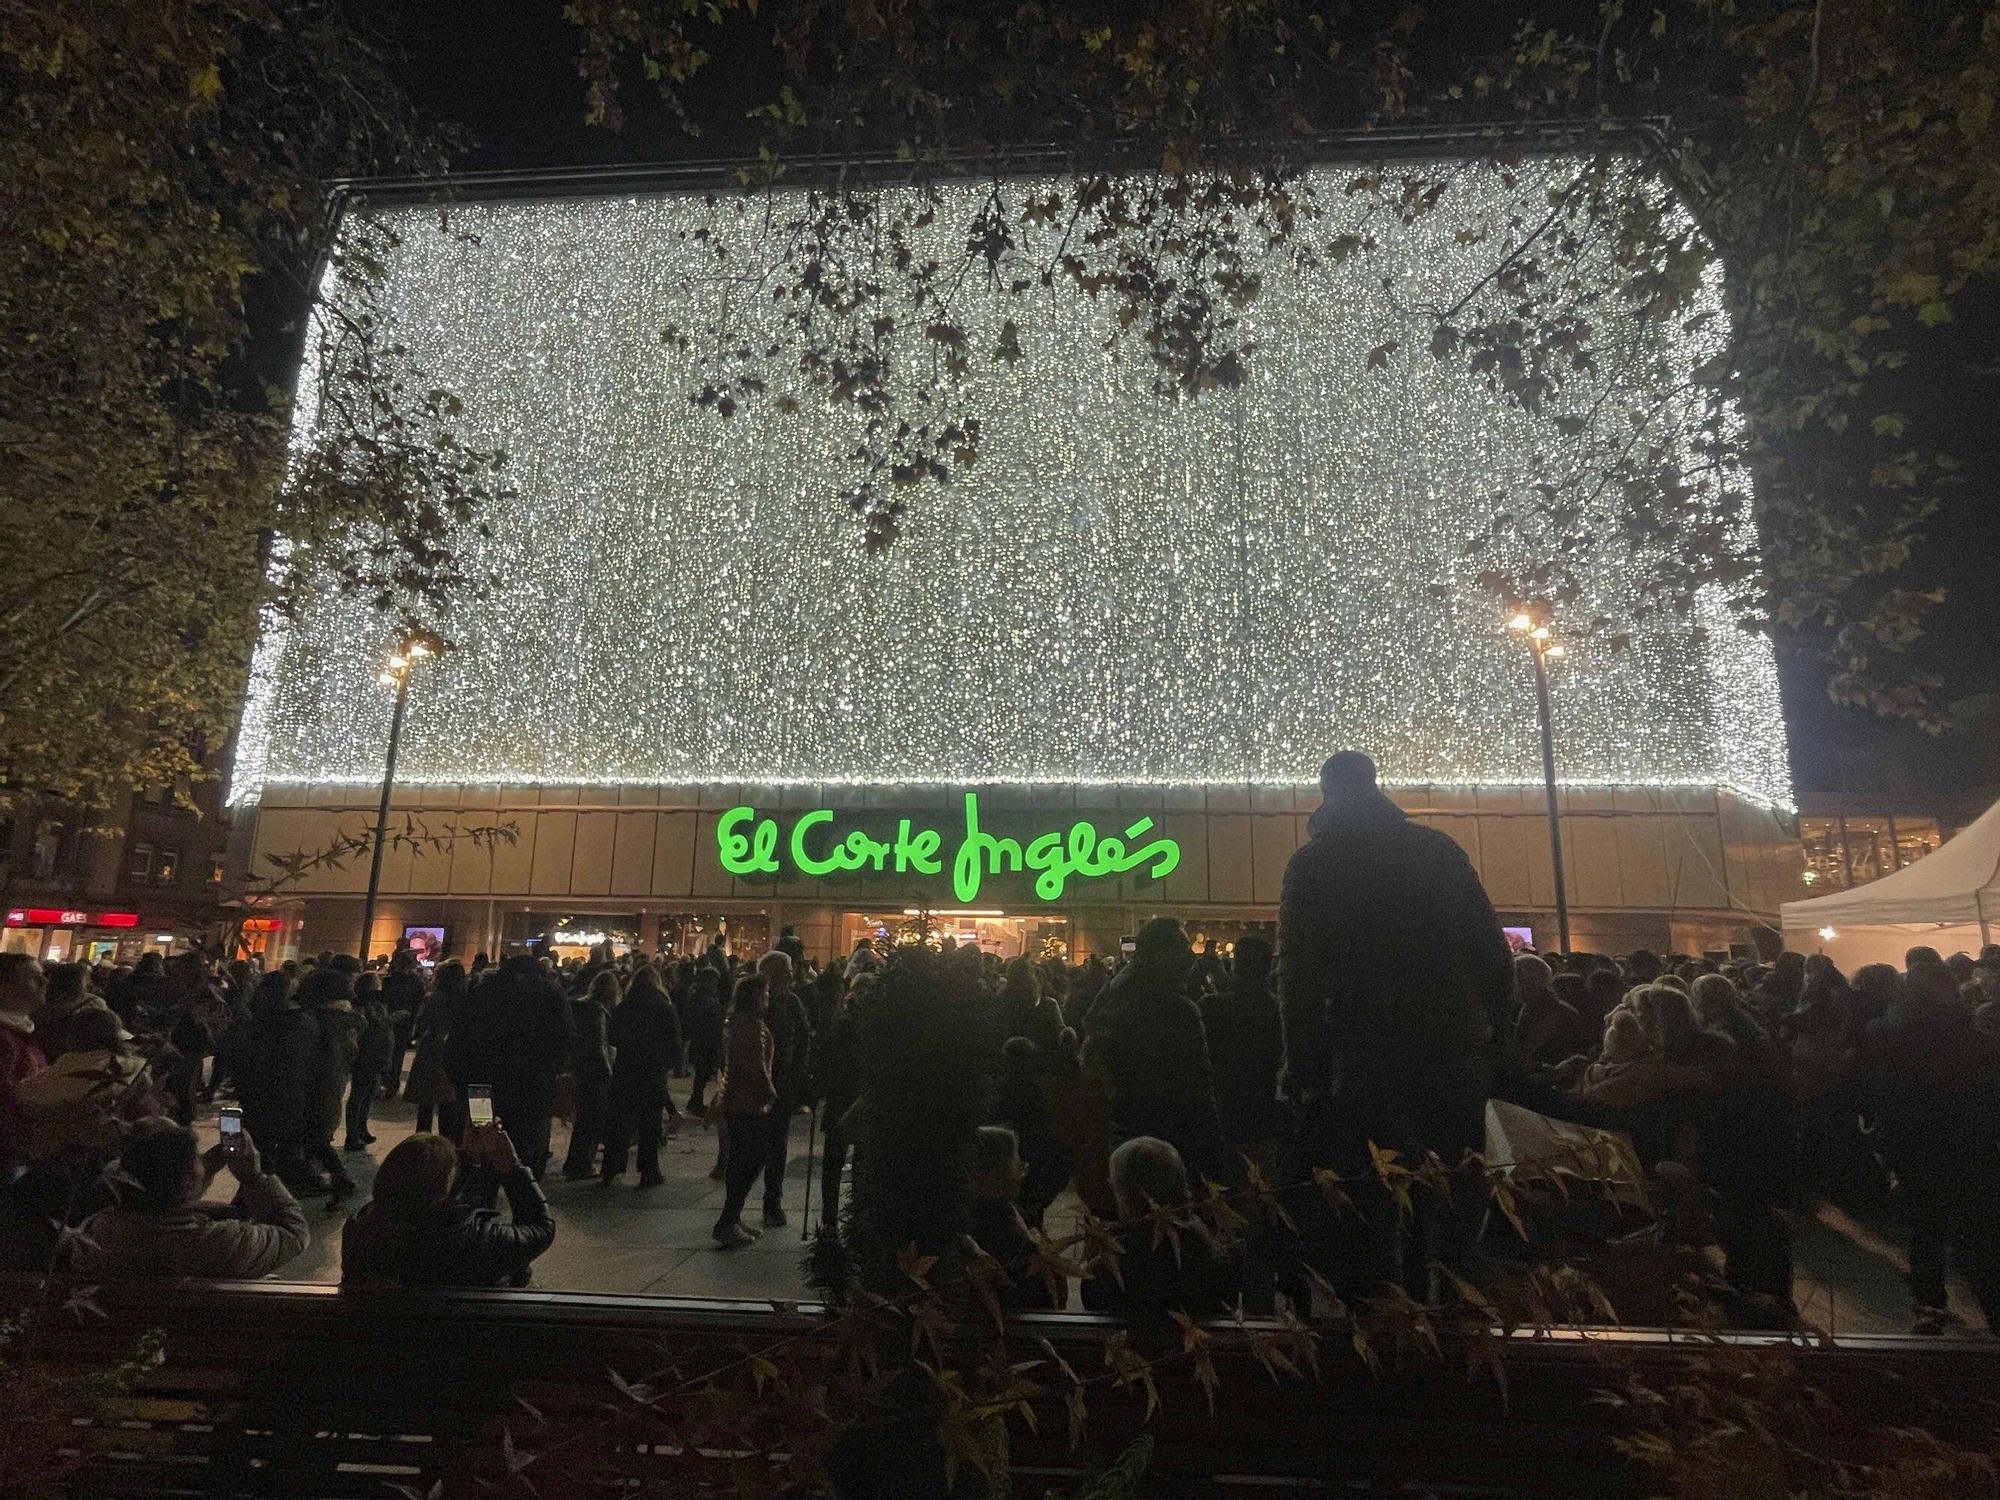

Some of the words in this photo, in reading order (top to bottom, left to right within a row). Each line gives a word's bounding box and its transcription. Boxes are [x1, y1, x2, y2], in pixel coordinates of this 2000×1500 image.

[716, 806, 780, 874] El
[790, 809, 942, 875] Corte
[953, 792, 1181, 903] Inglés
[61, 911, 87, 923] GAES
